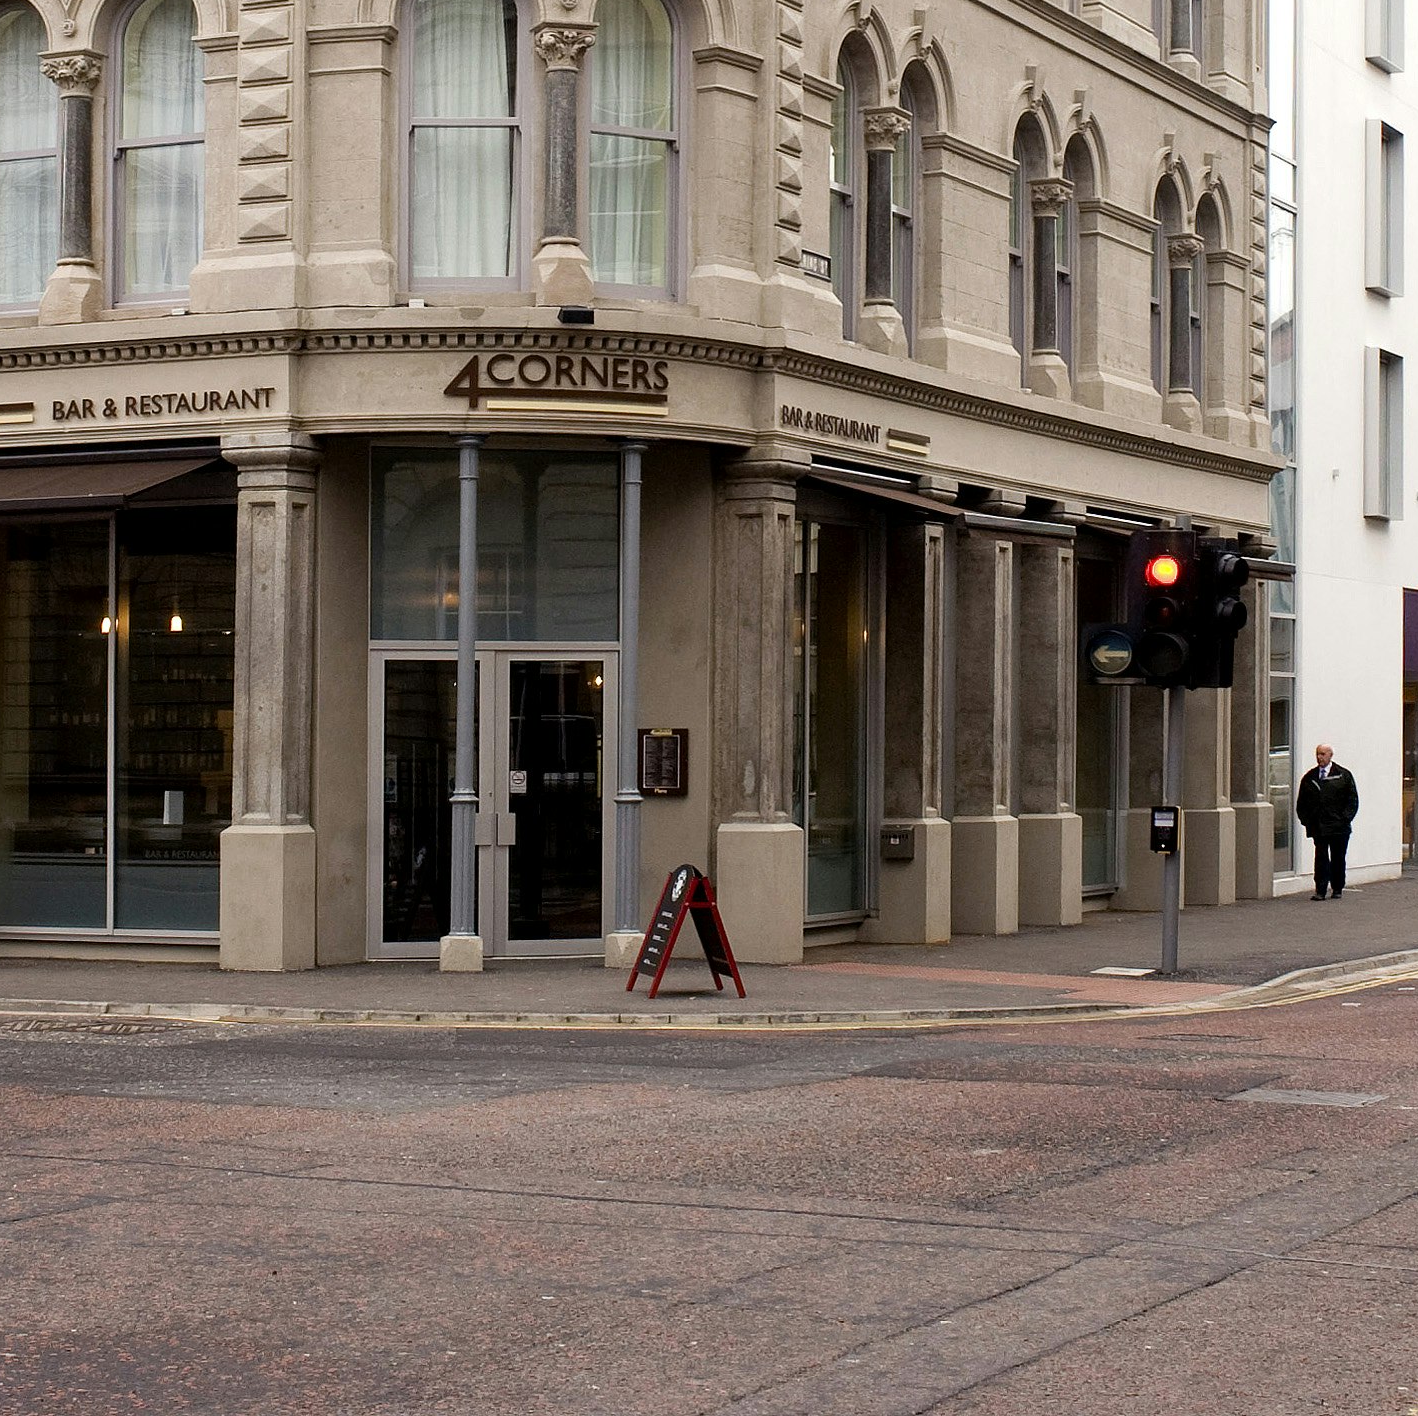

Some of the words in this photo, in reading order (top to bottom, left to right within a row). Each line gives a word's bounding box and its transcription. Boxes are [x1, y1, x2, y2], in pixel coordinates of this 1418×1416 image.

[52, 398, 96, 421] BAR
[102, 397, 118, 417] &
[124, 387, 276, 417] RESTAURANT
[782, 404, 803, 428] BAR
[805, 414, 814, 431] &
[815, 412, 882, 444] RESTAURANT
